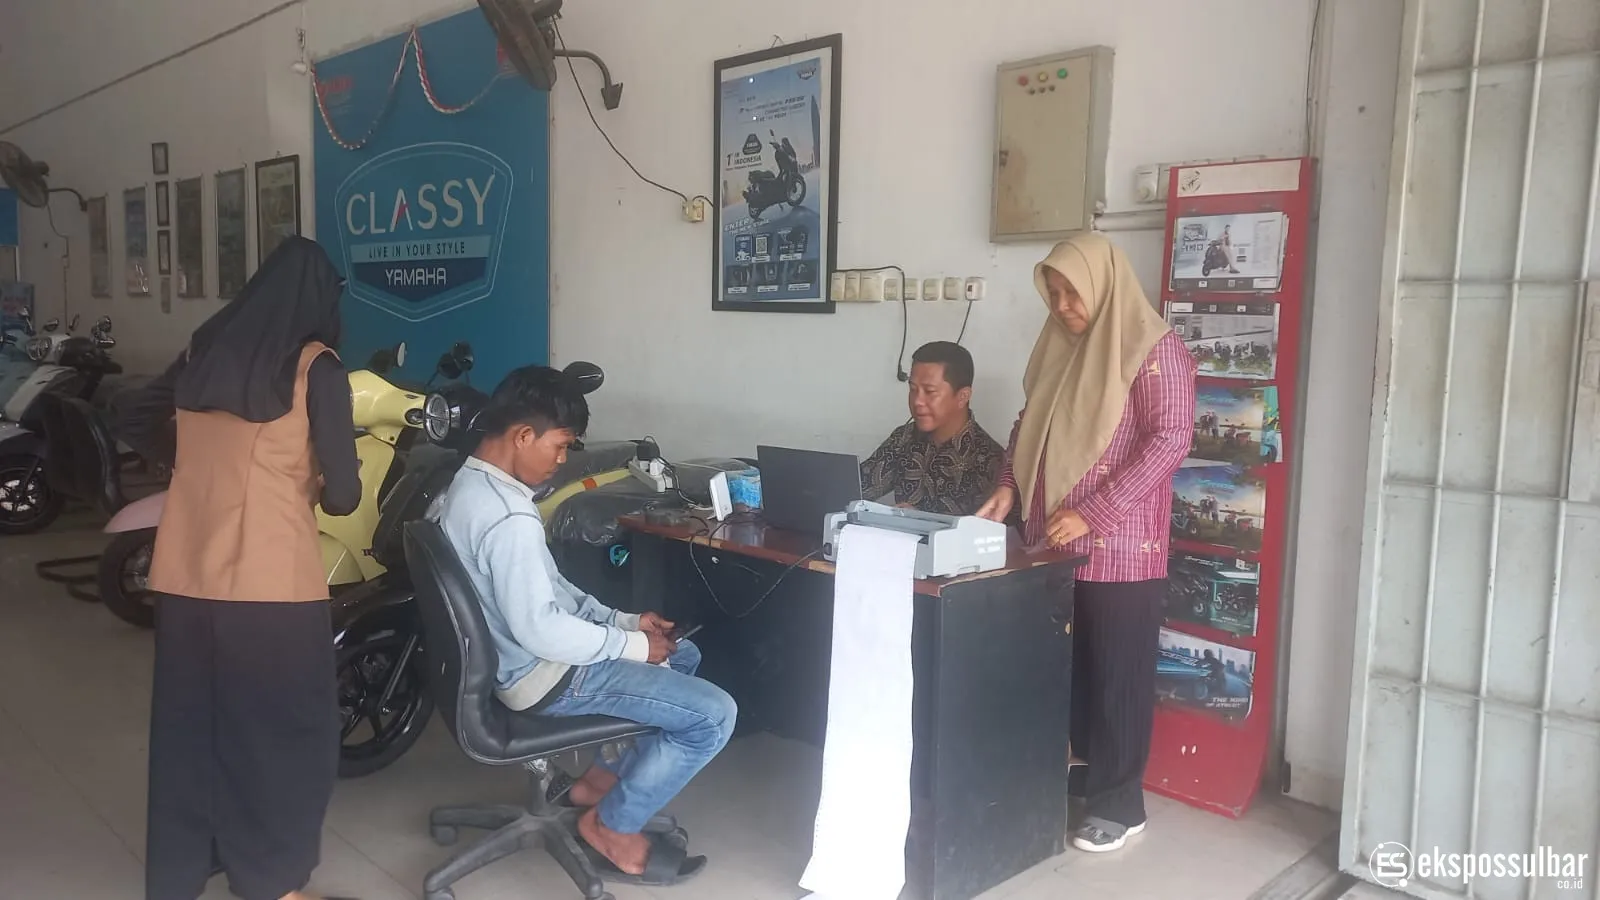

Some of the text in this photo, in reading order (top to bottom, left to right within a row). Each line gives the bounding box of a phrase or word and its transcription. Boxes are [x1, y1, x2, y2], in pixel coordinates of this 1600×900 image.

[346, 171, 496, 235] CLASSY
[369, 241, 465, 259] LIVE IN YOUR STYLE
[385, 267, 447, 286] YAMAHA
